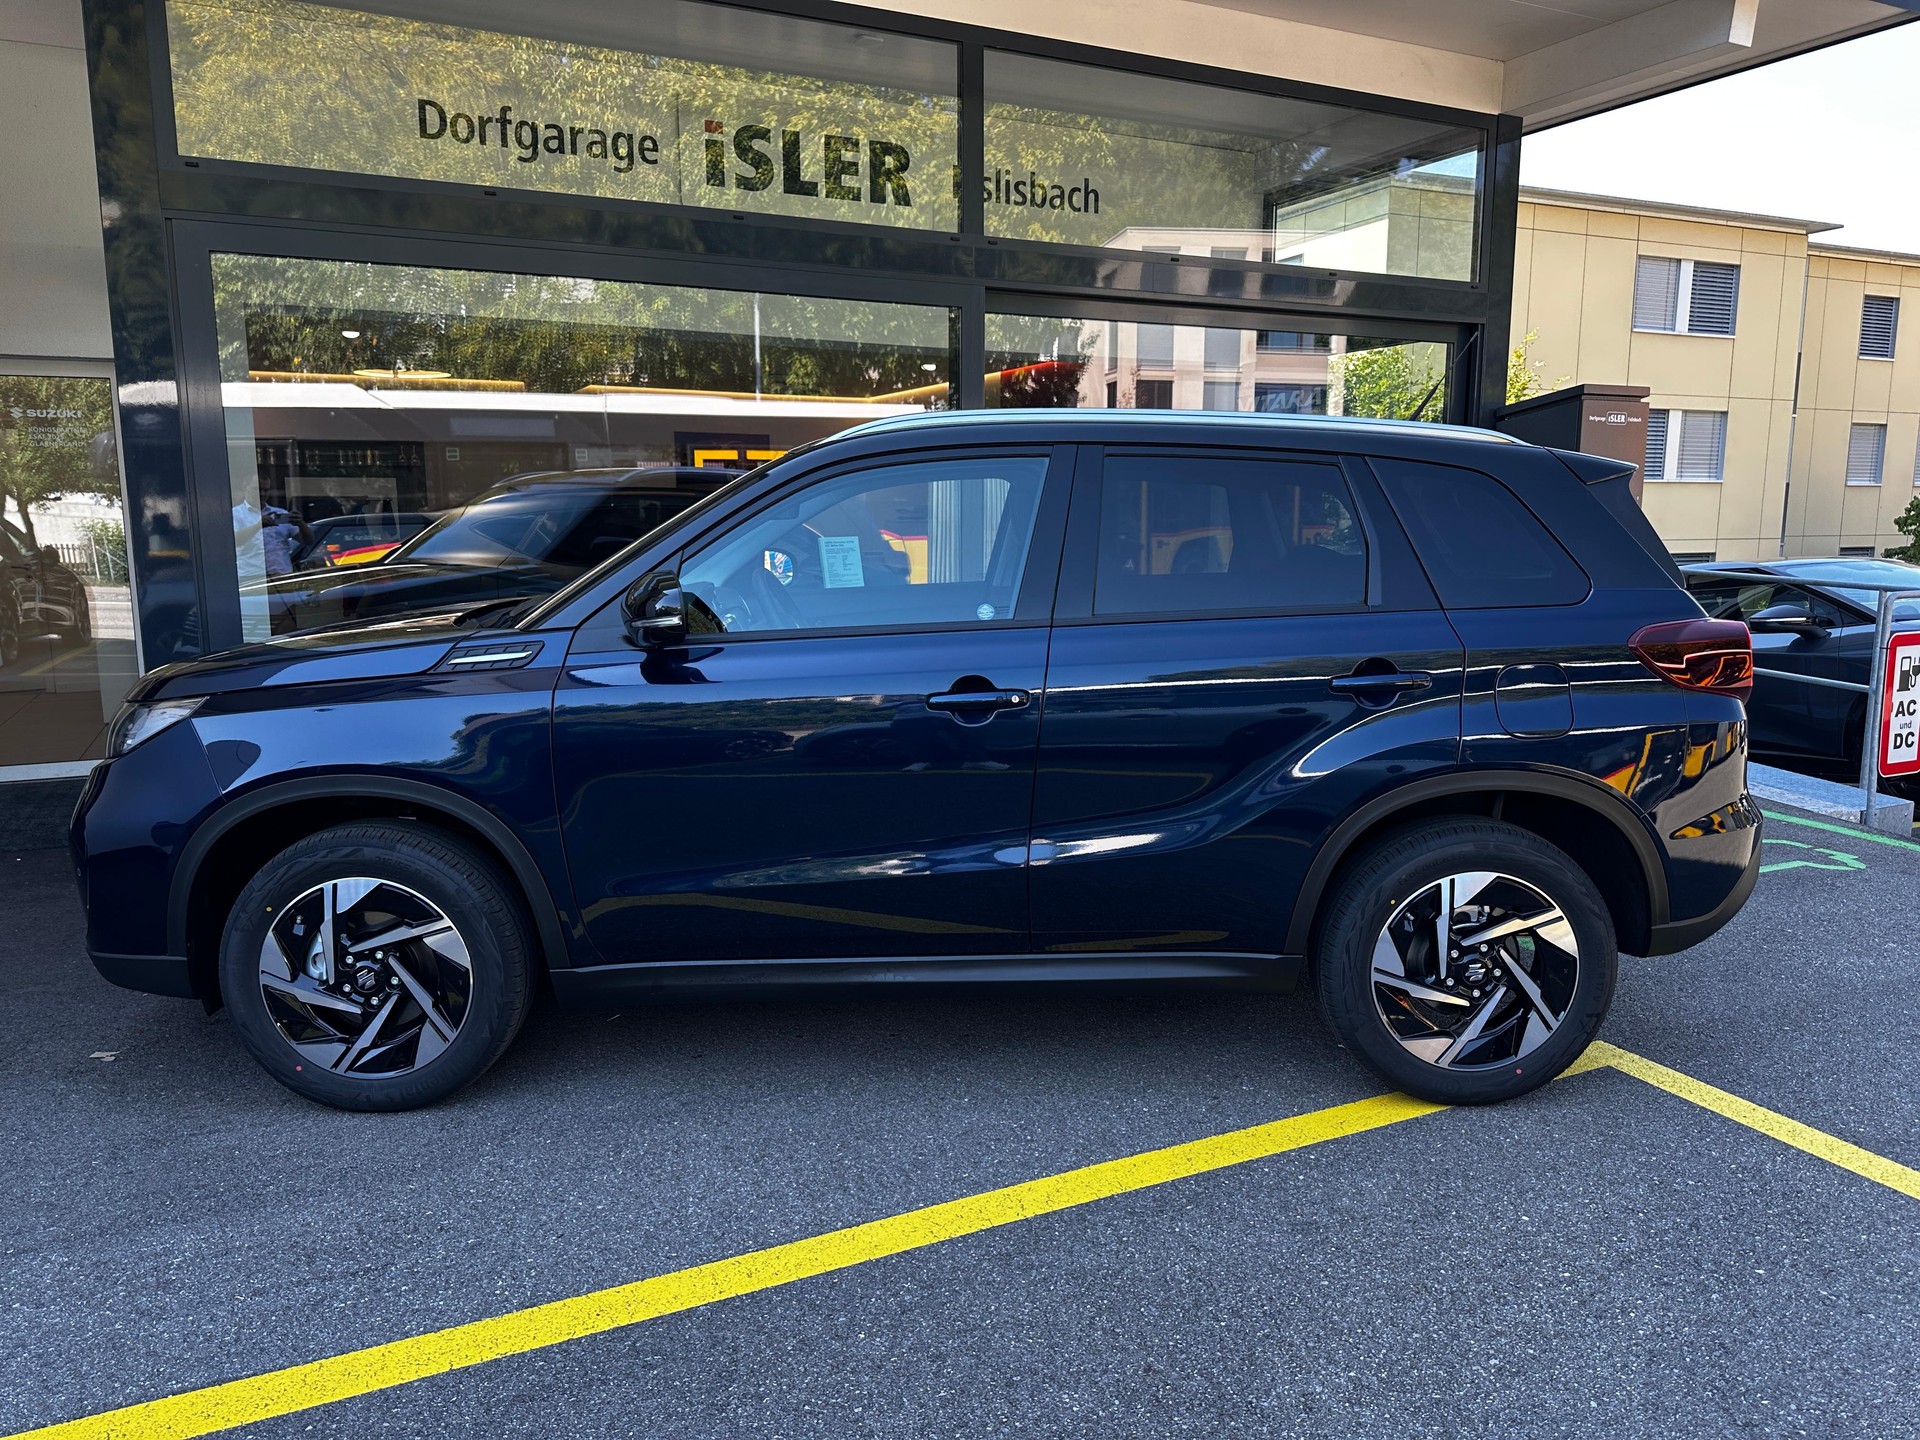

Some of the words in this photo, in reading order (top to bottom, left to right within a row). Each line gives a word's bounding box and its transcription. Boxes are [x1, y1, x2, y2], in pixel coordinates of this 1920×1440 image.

[417, 99, 660, 173] Dorfgarage
[953, 164, 1100, 214] slisbach
[26, 408, 82, 418] SUZUKI
[1894, 699, 1917, 718] AC
[1899, 720, 1913, 730] und
[1893, 731, 1915, 750] DC
